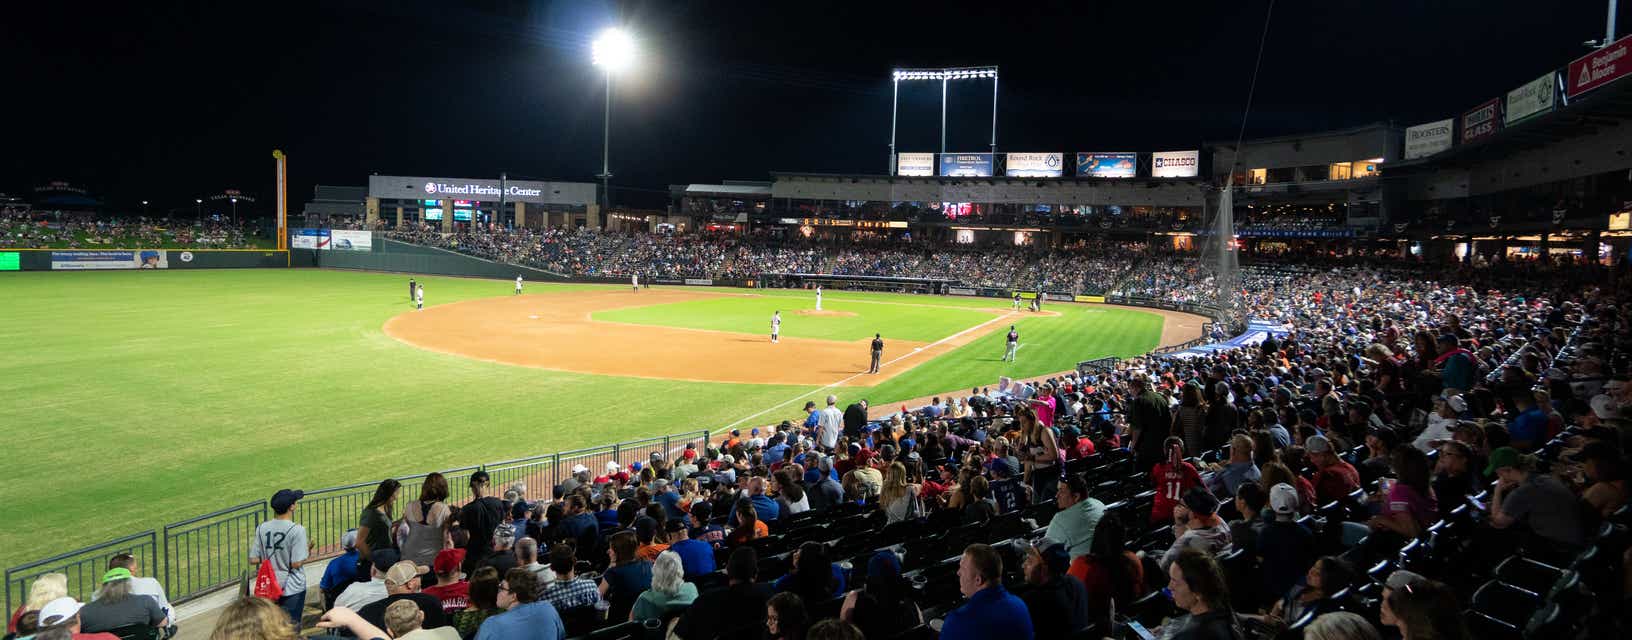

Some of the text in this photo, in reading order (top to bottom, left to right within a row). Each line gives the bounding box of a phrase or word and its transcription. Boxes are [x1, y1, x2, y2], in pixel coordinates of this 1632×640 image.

[1591, 46, 1627, 69] Benjamin
[1591, 64, 1616, 81] Moore
[1410, 126, 1449, 140] ROOSTERS
[1163, 157, 1196, 167] CHASCO
[437, 184, 467, 195] United
[510, 186, 542, 197] Center
[1166, 482, 1180, 500] 11
[265, 531, 286, 550] 12
